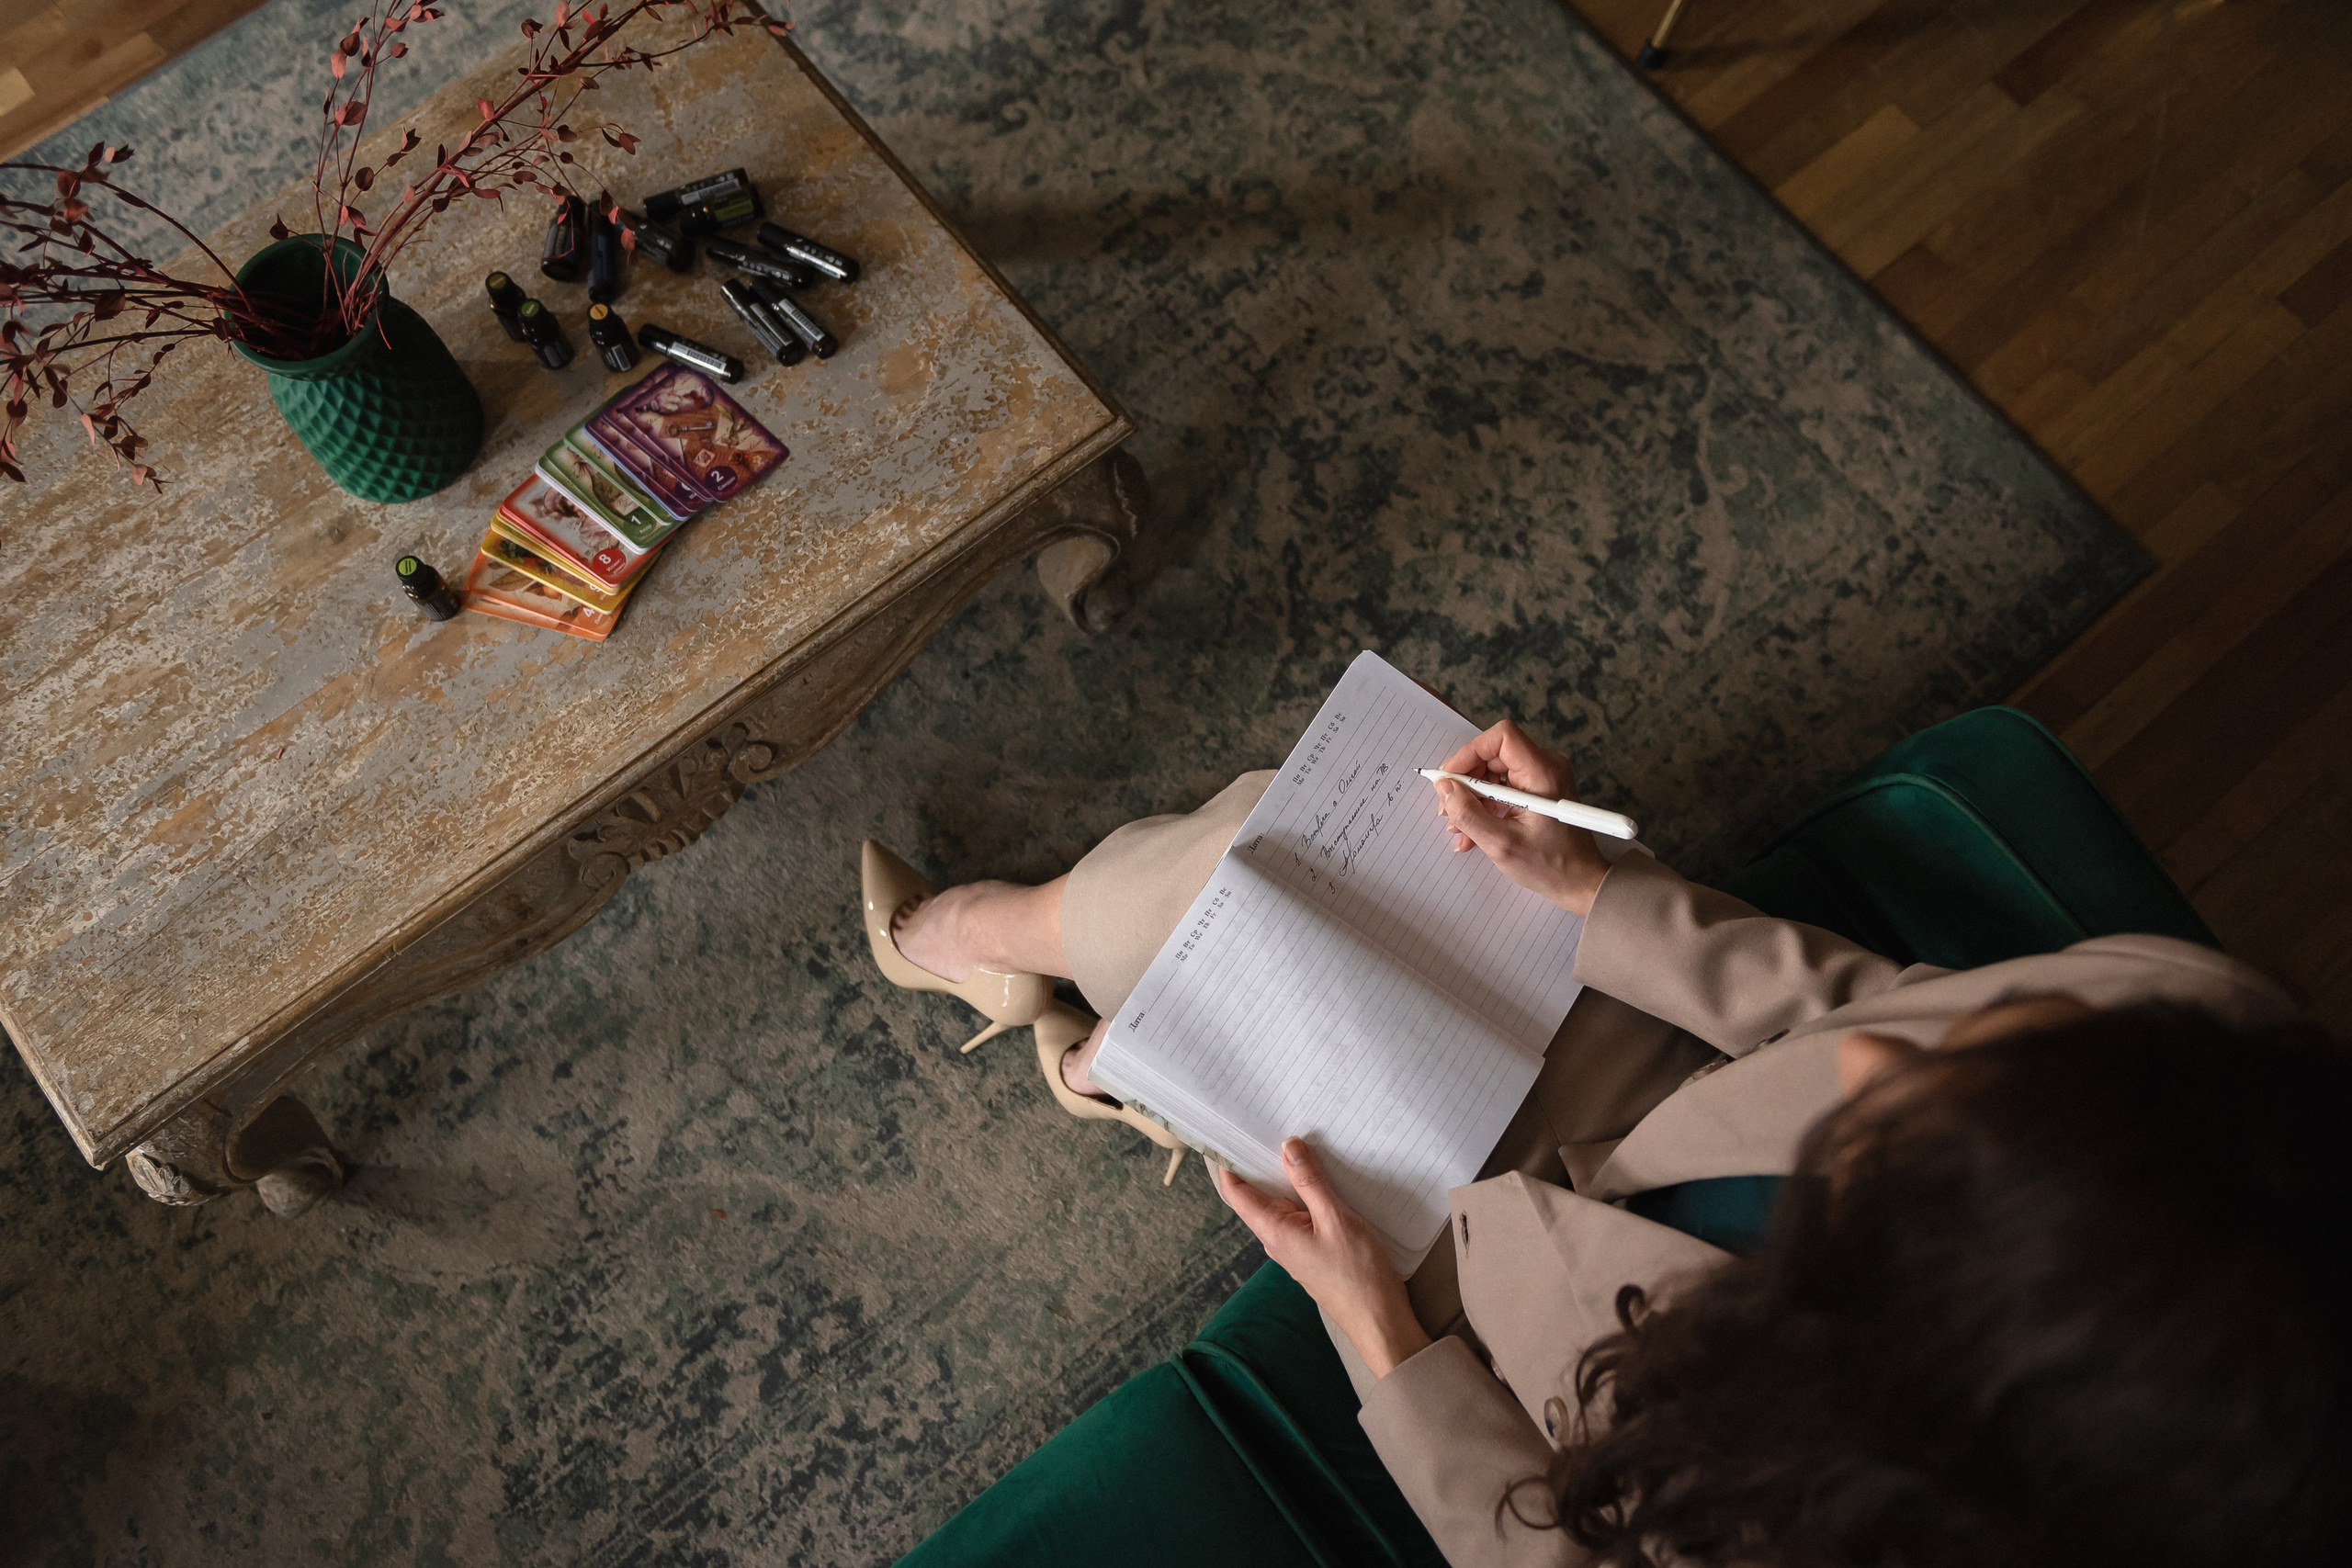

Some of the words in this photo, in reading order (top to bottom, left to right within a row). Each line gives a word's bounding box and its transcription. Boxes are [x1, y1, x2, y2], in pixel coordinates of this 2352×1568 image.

[710, 470, 724, 482] 2
[631, 514, 641, 525] 1
[598, 553, 612, 565] 8
[582, 607, 595, 617] 4
[1247, 832, 1265, 855] Дата:
[1127, 1010, 1147, 1033] Дата:
